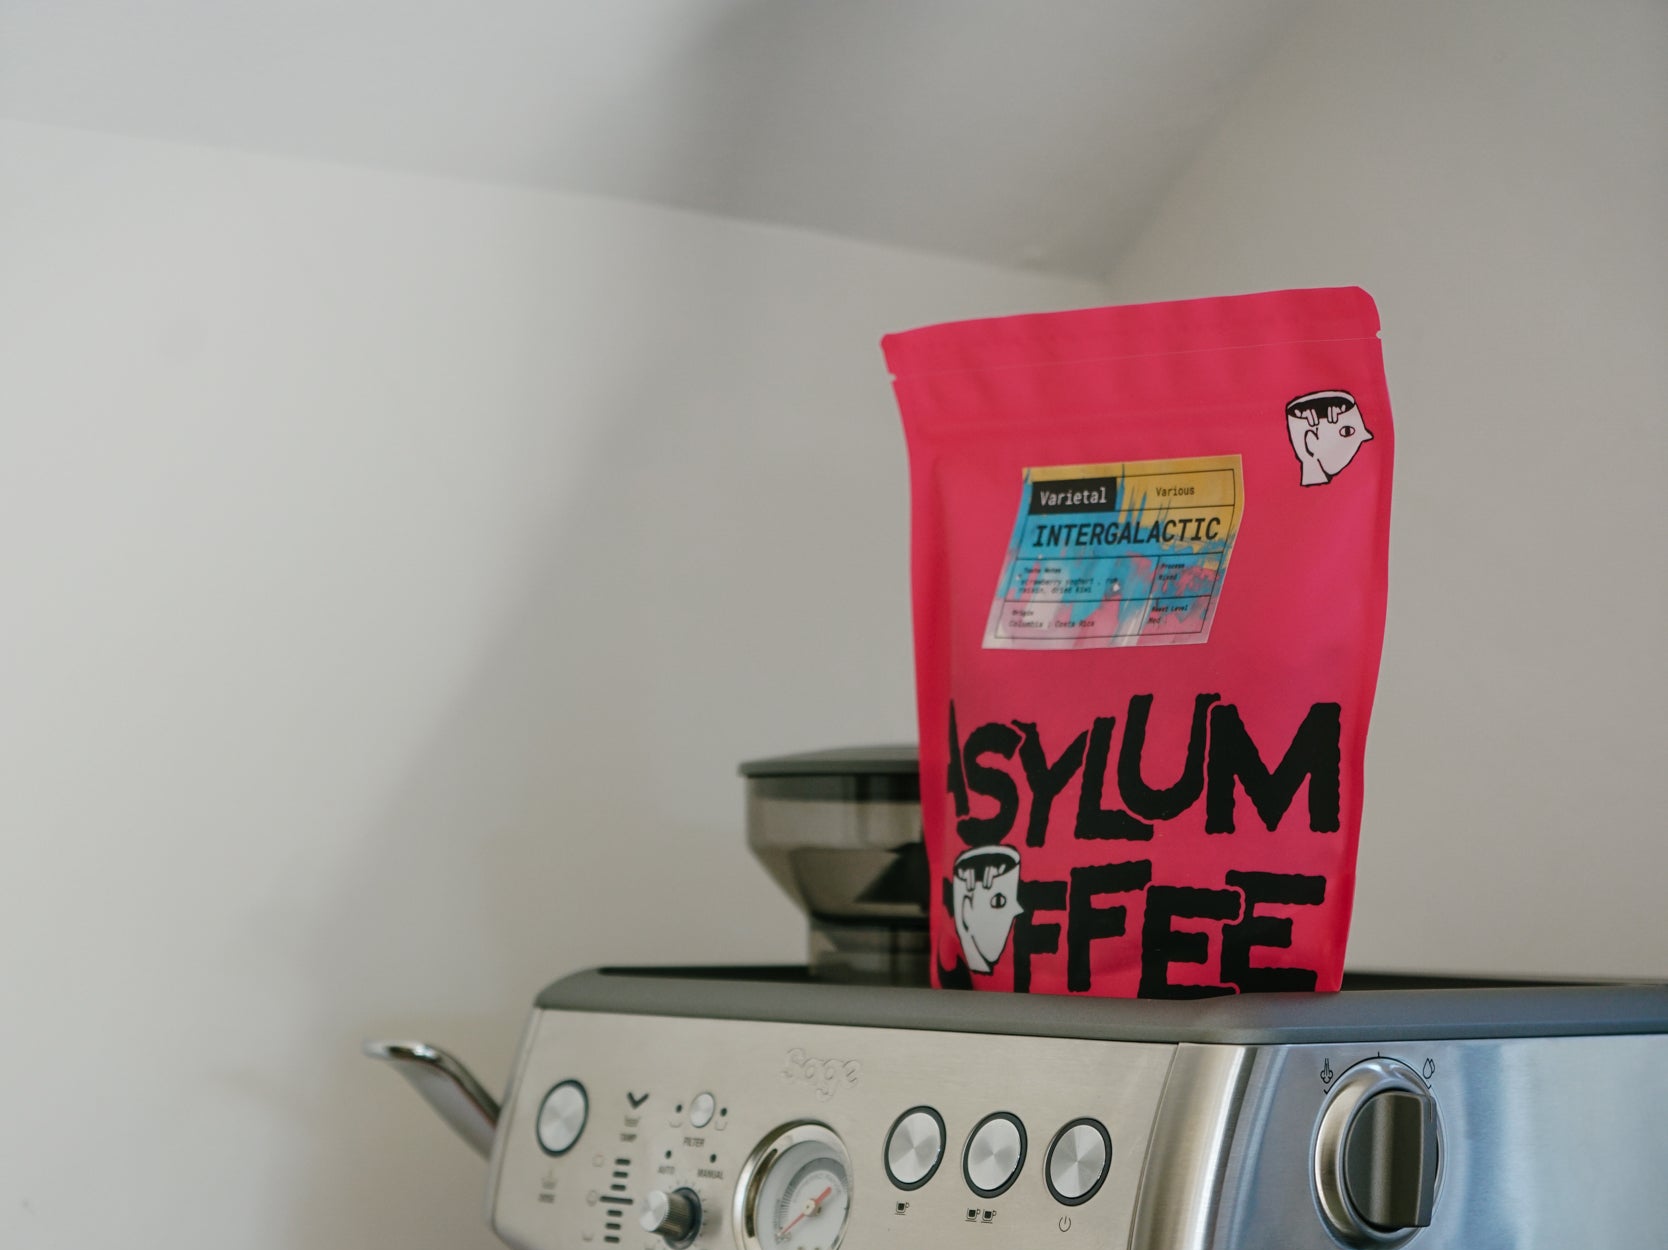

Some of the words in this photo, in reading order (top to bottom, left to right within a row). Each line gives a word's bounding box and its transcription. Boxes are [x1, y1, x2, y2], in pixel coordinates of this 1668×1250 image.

[1040, 487, 1107, 506] Varietal
[1156, 486, 1195, 497] Various
[1033, 517, 1221, 547] INTERGALACTIC
[938, 859, 1326, 999] FFEE
[779, 1047, 862, 1103] Sage
[697, 1168, 724, 1180] MANUAL
